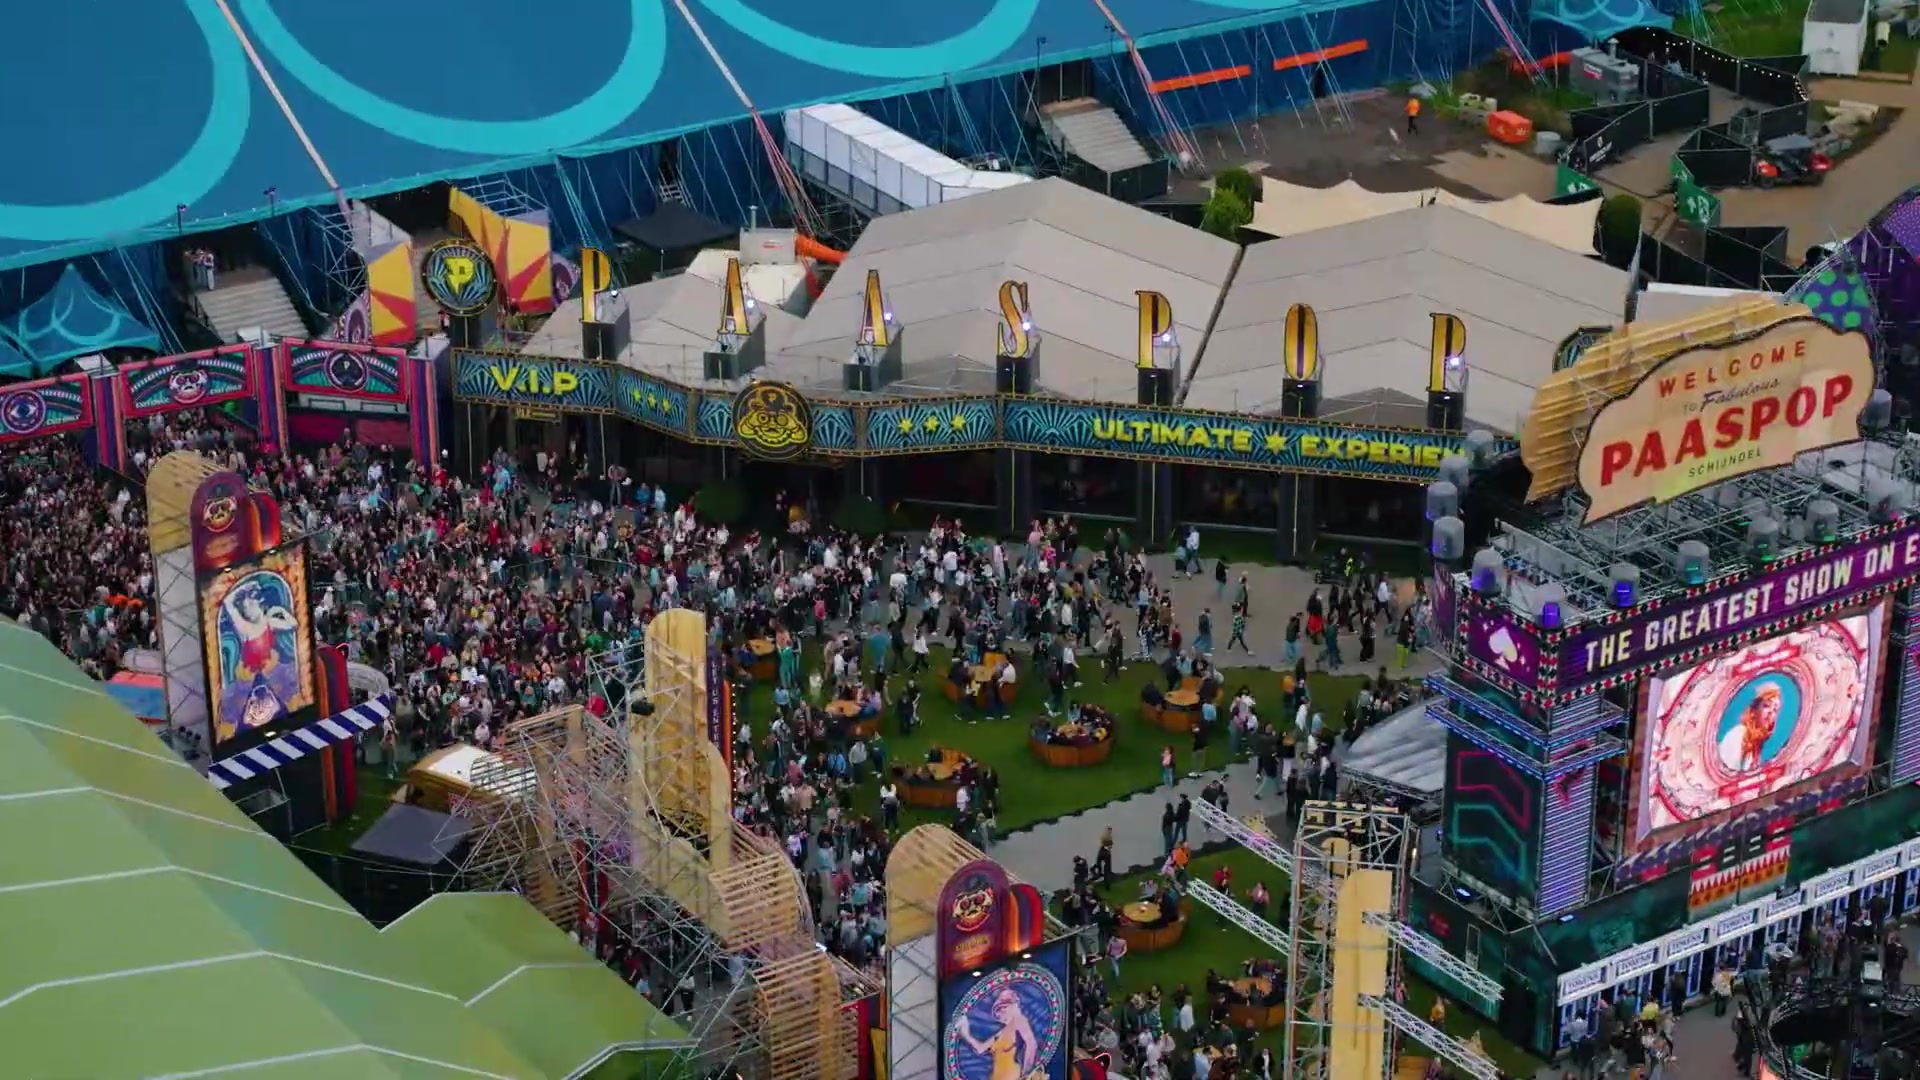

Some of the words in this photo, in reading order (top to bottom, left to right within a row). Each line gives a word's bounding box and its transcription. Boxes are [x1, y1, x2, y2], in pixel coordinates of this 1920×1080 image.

[1659, 340, 1806, 398] WELCOME
[1093, 416, 1254, 451] ULTIMATE
[1600, 374, 1853, 487] PAASPOP
[1688, 447, 1761, 478] SCHIJNDEL
[1585, 629, 1633, 673] THE
[1644, 582, 1775, 652] GREATEST
[1784, 556, 1854, 605] SHOW
[1864, 540, 1896, 578] ON
